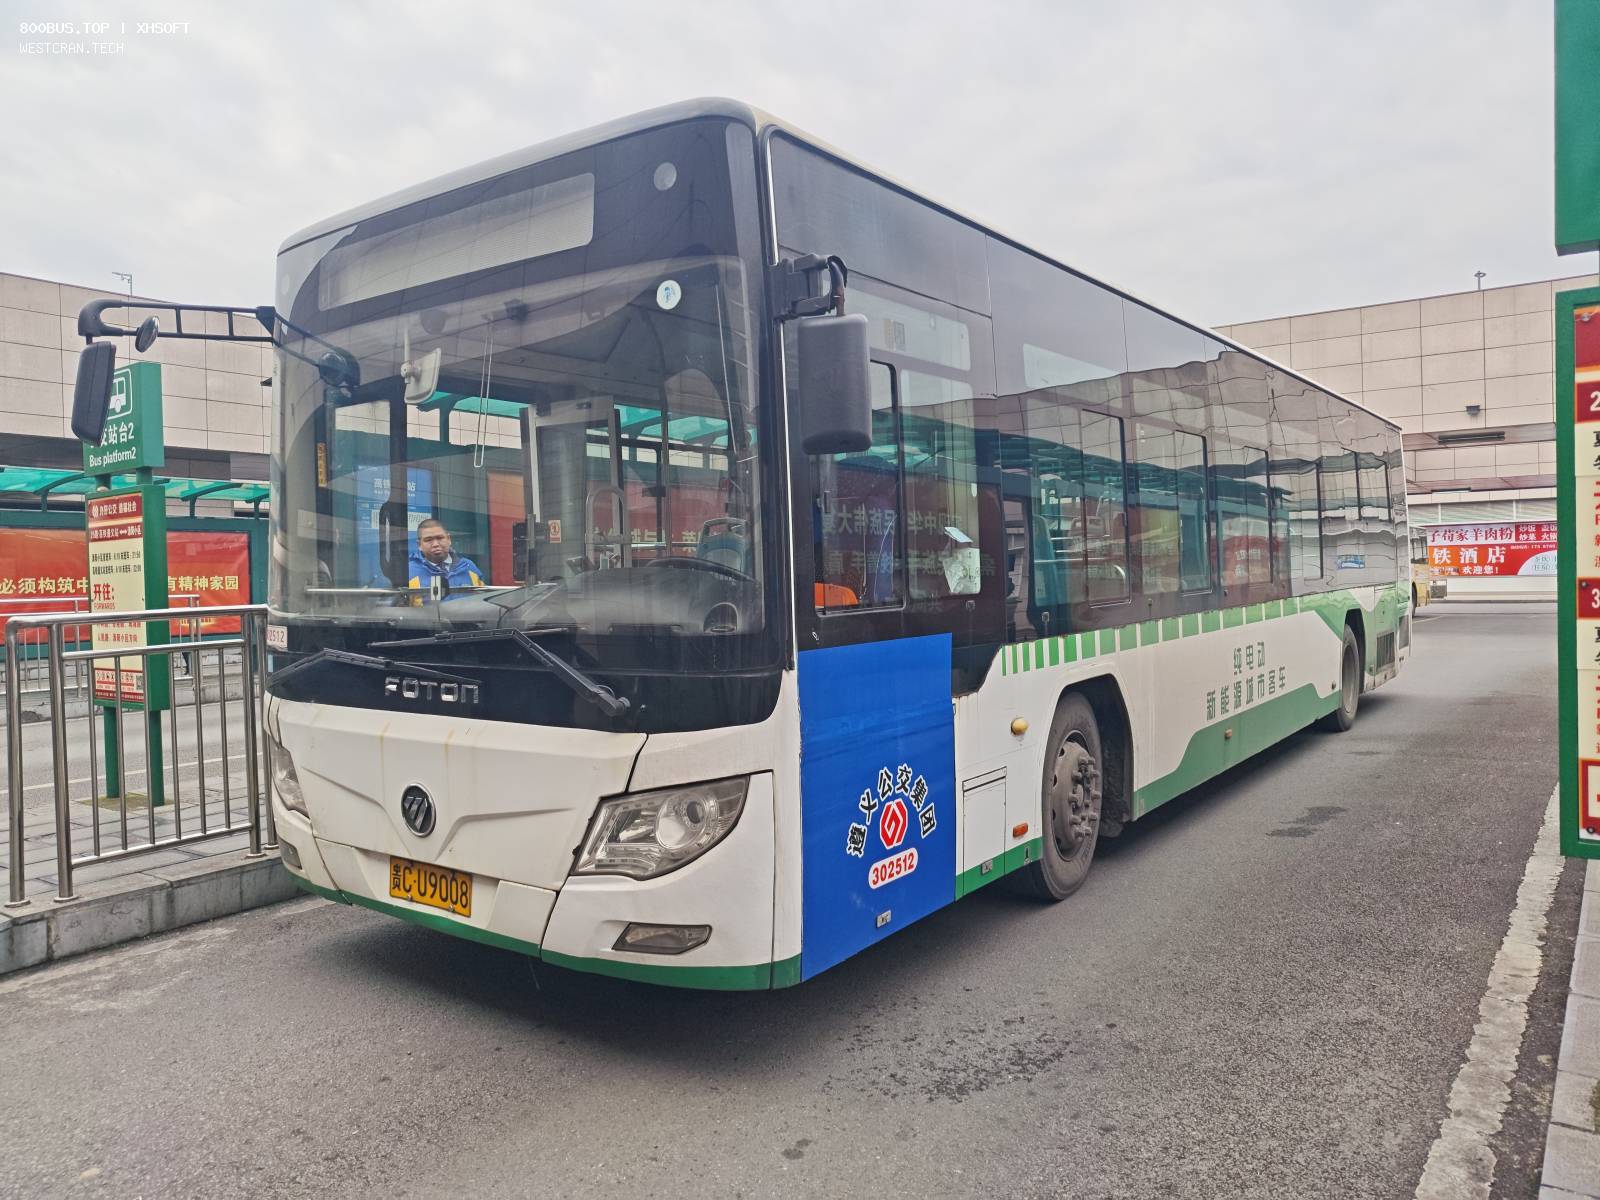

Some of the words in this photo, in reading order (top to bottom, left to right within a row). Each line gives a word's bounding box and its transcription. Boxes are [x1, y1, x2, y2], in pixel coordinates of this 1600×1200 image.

[89, 455, 102, 467] Bus
[103, 447, 136, 467] platform2
[1234, 642, 1265, 675] 纯电动
[385, 677, 480, 704] FOTON
[1207, 665, 1286, 720] 新能源城市客车
[872, 853, 915, 885] 302512
